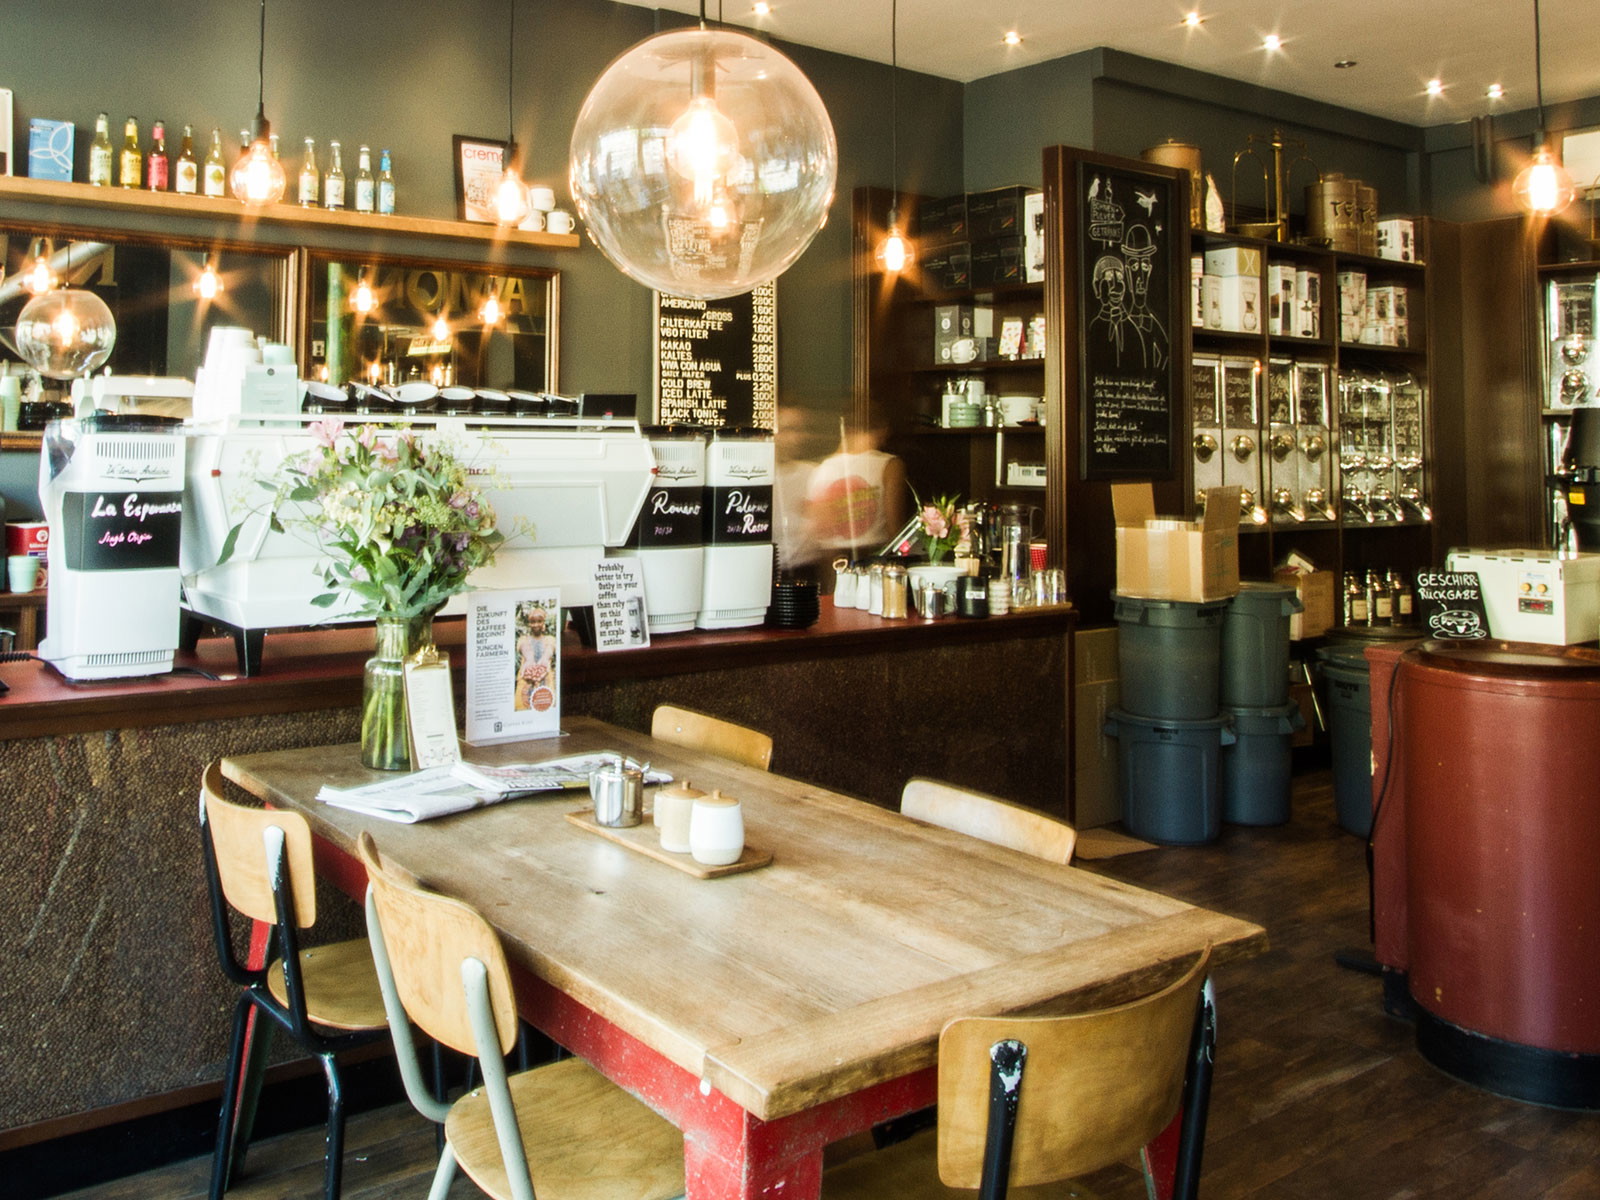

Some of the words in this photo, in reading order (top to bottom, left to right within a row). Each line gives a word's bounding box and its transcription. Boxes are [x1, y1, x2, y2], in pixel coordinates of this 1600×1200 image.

[661, 299, 707, 310] AMERICANO
[661, 318, 723, 331] FILTERKAFFEE
[660, 328, 679, 338] V60
[680, 329, 708, 339] FILTER
[661, 340, 692, 351] KAKAO
[661, 351, 693, 361] KALTES
[661, 361, 679, 370] VIVA
[680, 362, 698, 371] CON
[699, 362, 721, 372] AGUA
[736, 373, 751, 381] PLUS
[661, 379, 684, 389] COLD
[686, 379, 711, 389] BREW
[662, 388, 683, 398] ICED
[686, 390, 712, 399] LATTE
[661, 399, 698, 409] SPANISH
[702, 400, 727, 409] LATTE
[661, 408, 690, 418] BLACK
[692, 409, 719, 418] TONIC
[91, 494, 117, 518] La
[725, 490, 769, 515] Palermo
[742, 513, 769, 534] Rosso
[598, 563, 624, 573] Probably
[594, 573, 614, 581] better
[623, 572, 633, 581] try
[624, 582, 637, 591] your
[598, 591, 617, 600] coffee
[597, 601, 611, 609] than
[612, 600, 625, 610] rely
[476, 611, 507, 619] ZUKUNFT
[613, 618, 623, 626] for
[476, 624, 507, 632] KAFFEES
[476, 630, 505, 639] BEGINNT
[476, 644, 504, 652] JUNGEN
[476, 650, 509, 658] FARMERN
